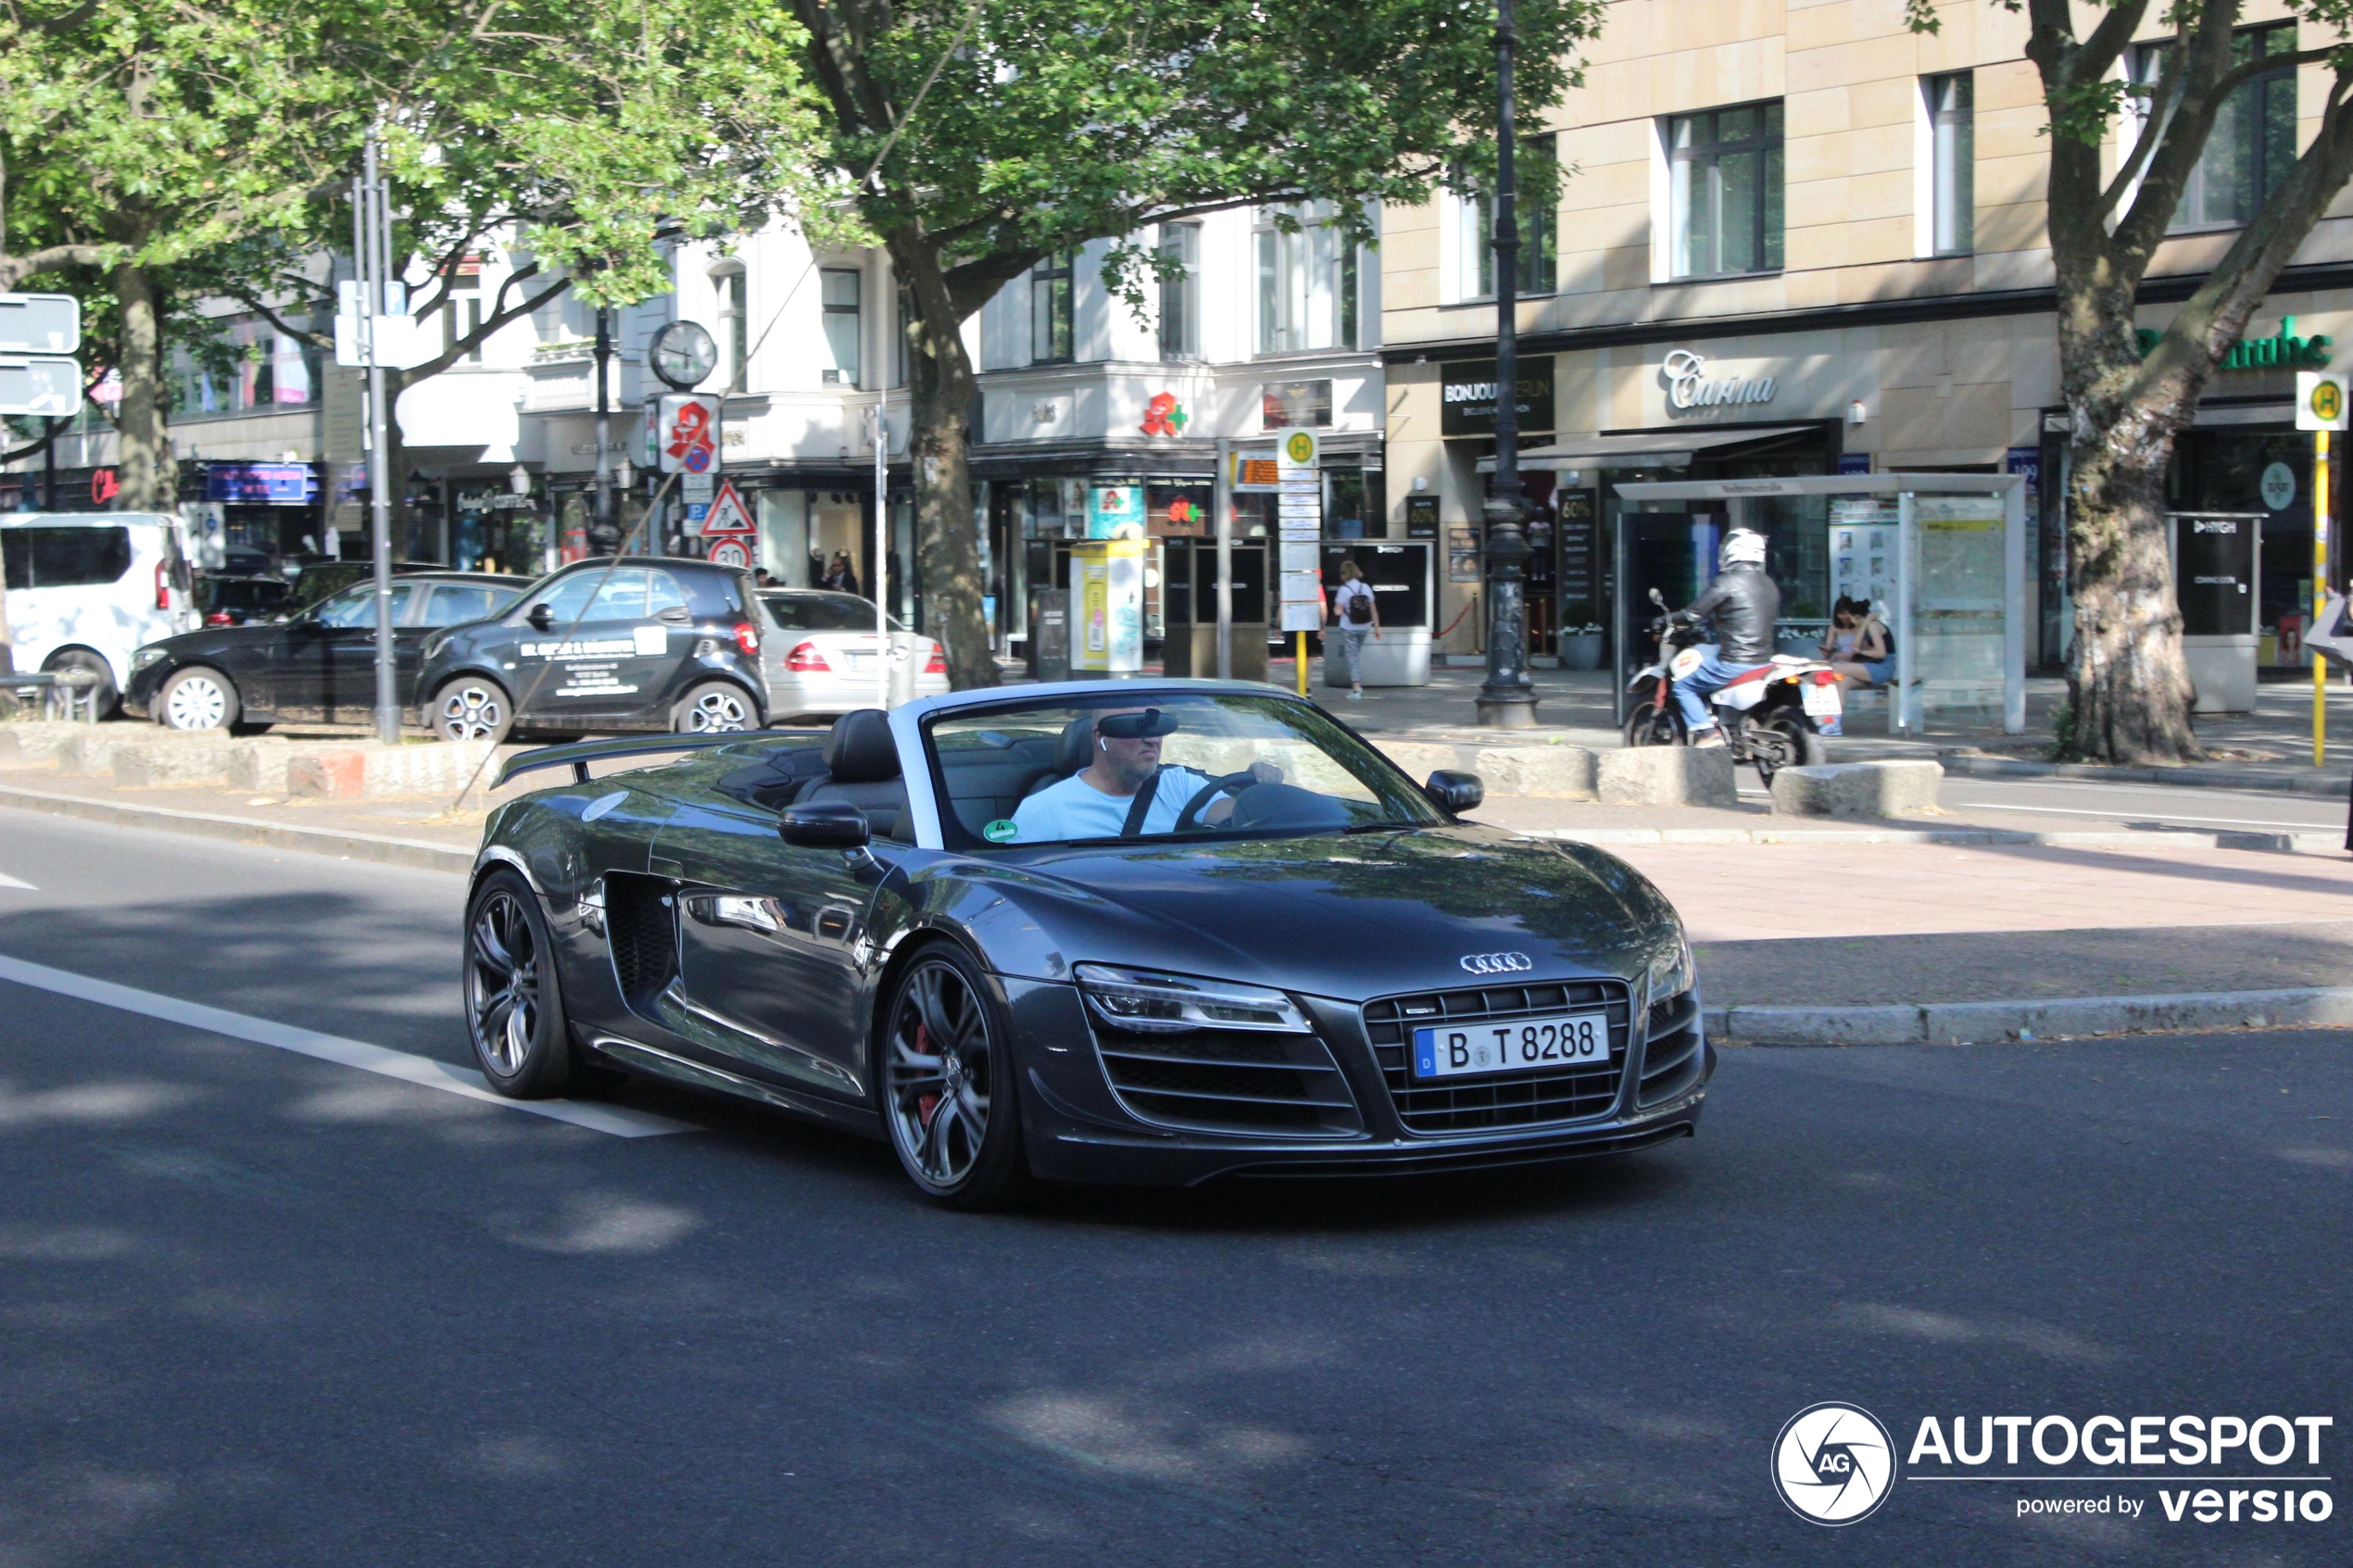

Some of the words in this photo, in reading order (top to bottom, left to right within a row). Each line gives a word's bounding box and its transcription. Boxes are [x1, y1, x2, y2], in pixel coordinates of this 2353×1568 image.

[1445, 383, 1499, 402] BONJOU
[1663, 349, 1777, 408] Carina
[1449, 1033, 1469, 1068] B
[1492, 1028, 1511, 1063] T
[1522, 1022, 1595, 1061] 8288
[1422, 1058, 1430, 1069] D
